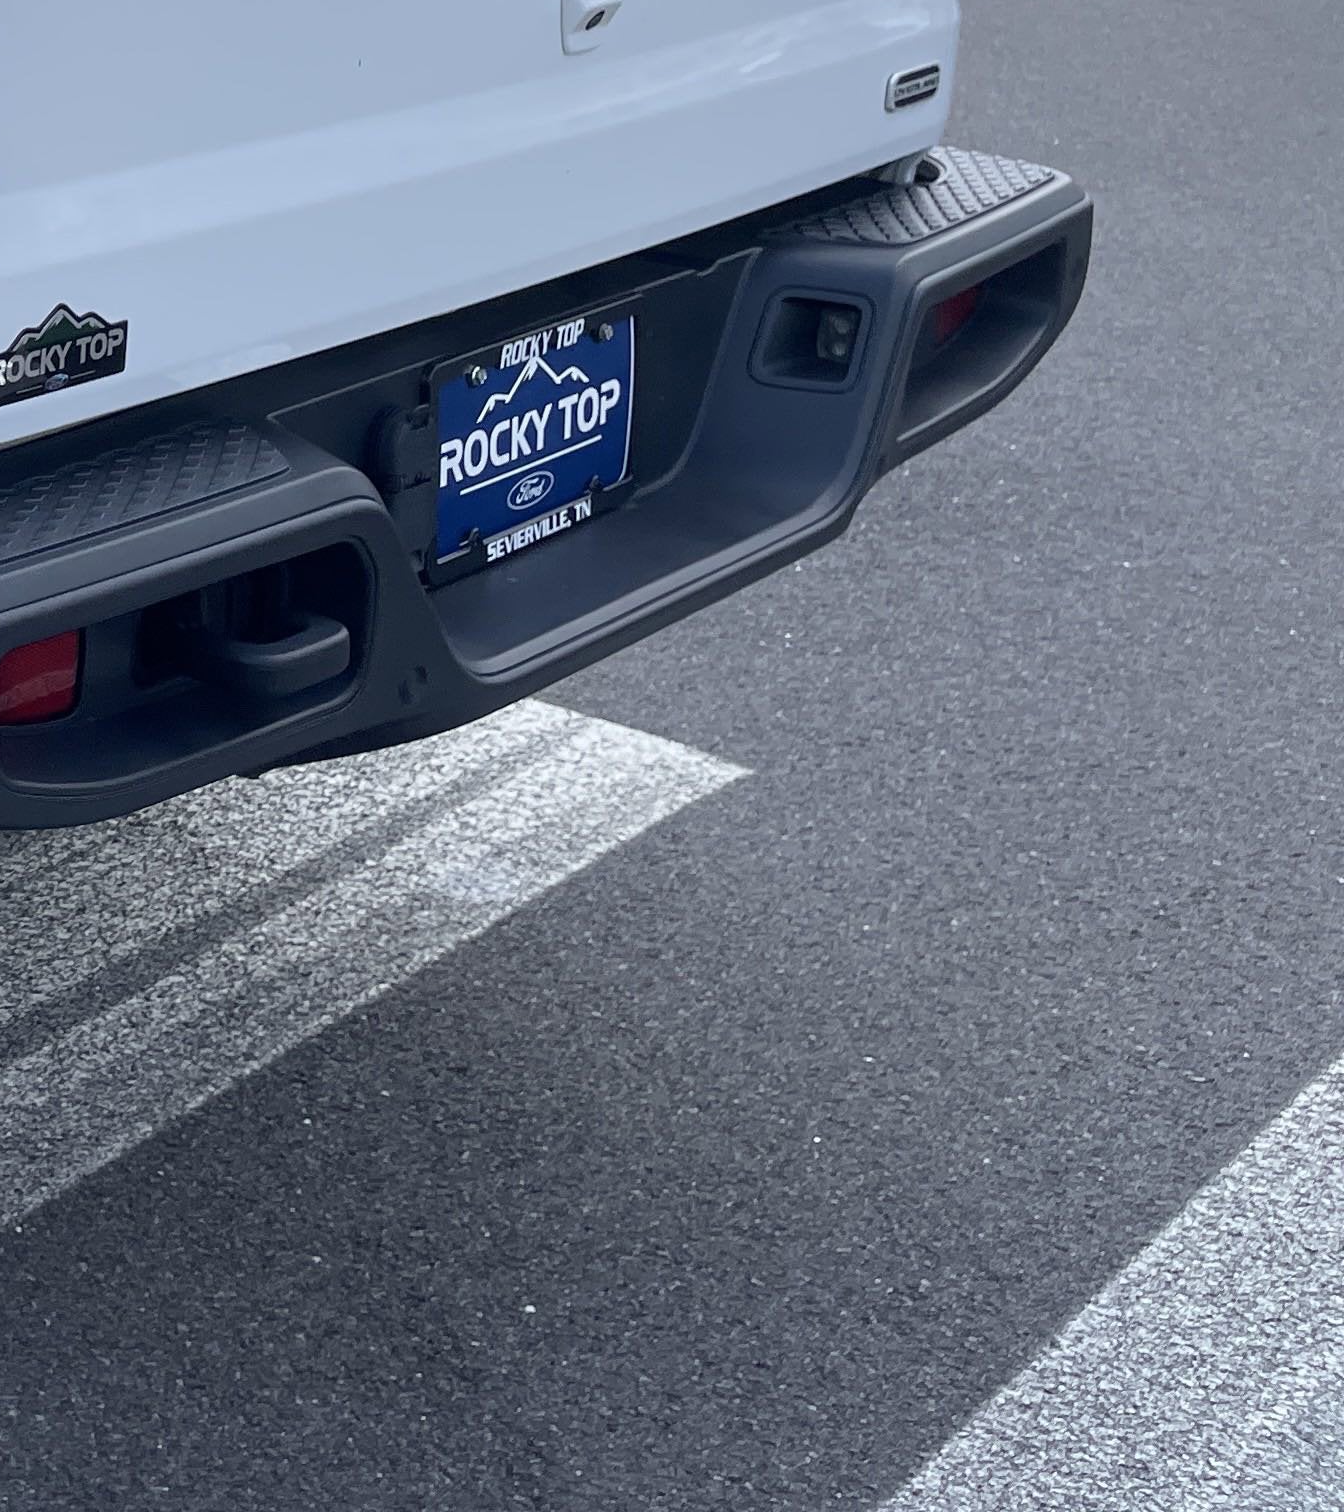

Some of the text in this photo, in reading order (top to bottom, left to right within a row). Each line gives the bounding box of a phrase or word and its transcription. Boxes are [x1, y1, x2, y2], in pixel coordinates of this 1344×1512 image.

[75, 327, 125, 366] TOP
[499, 317, 586, 370] ROCKY TOP
[439, 378, 621, 489] ROCKY TOP
[515, 477, 546, 505] Ford
[486, 498, 592, 563] SEVIERVILLE, TN
